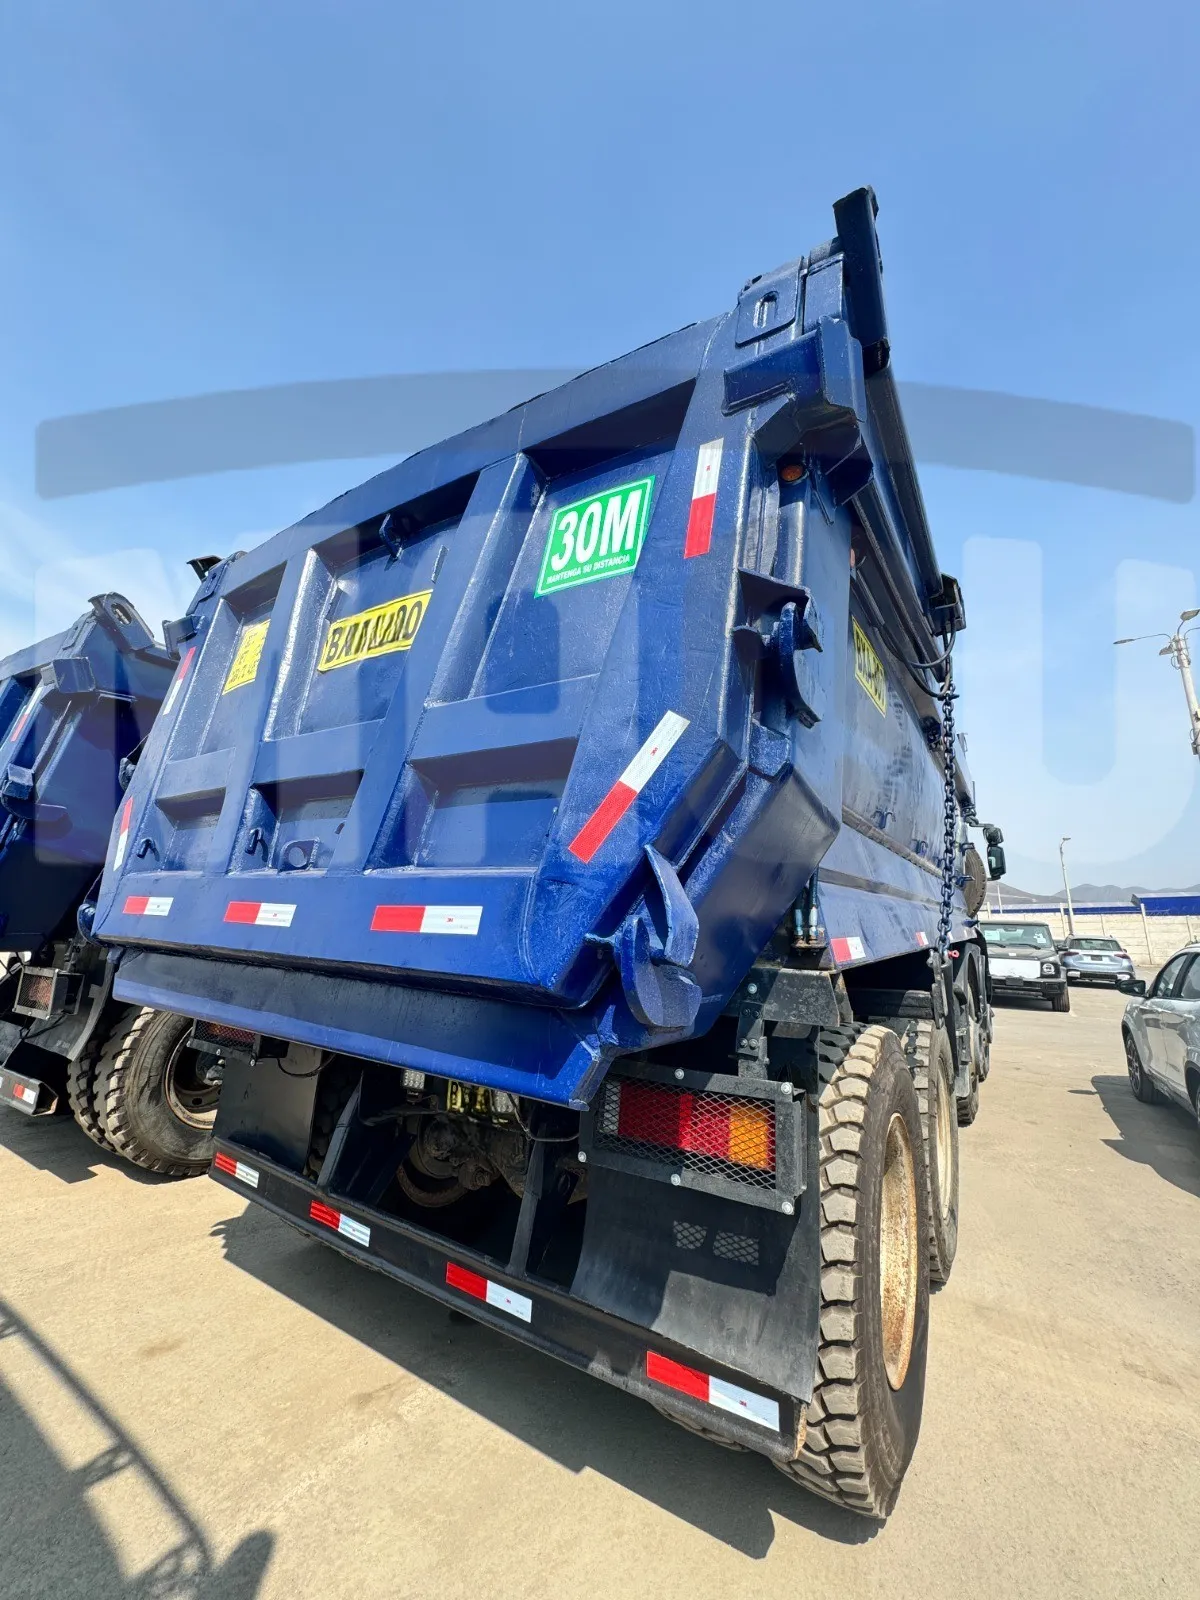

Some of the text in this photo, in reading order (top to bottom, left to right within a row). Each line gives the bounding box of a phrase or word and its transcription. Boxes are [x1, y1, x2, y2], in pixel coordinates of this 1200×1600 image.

[550, 489, 642, 571] 30M
[546, 554, 630, 584] MANTENGA SU DISTANCIA
